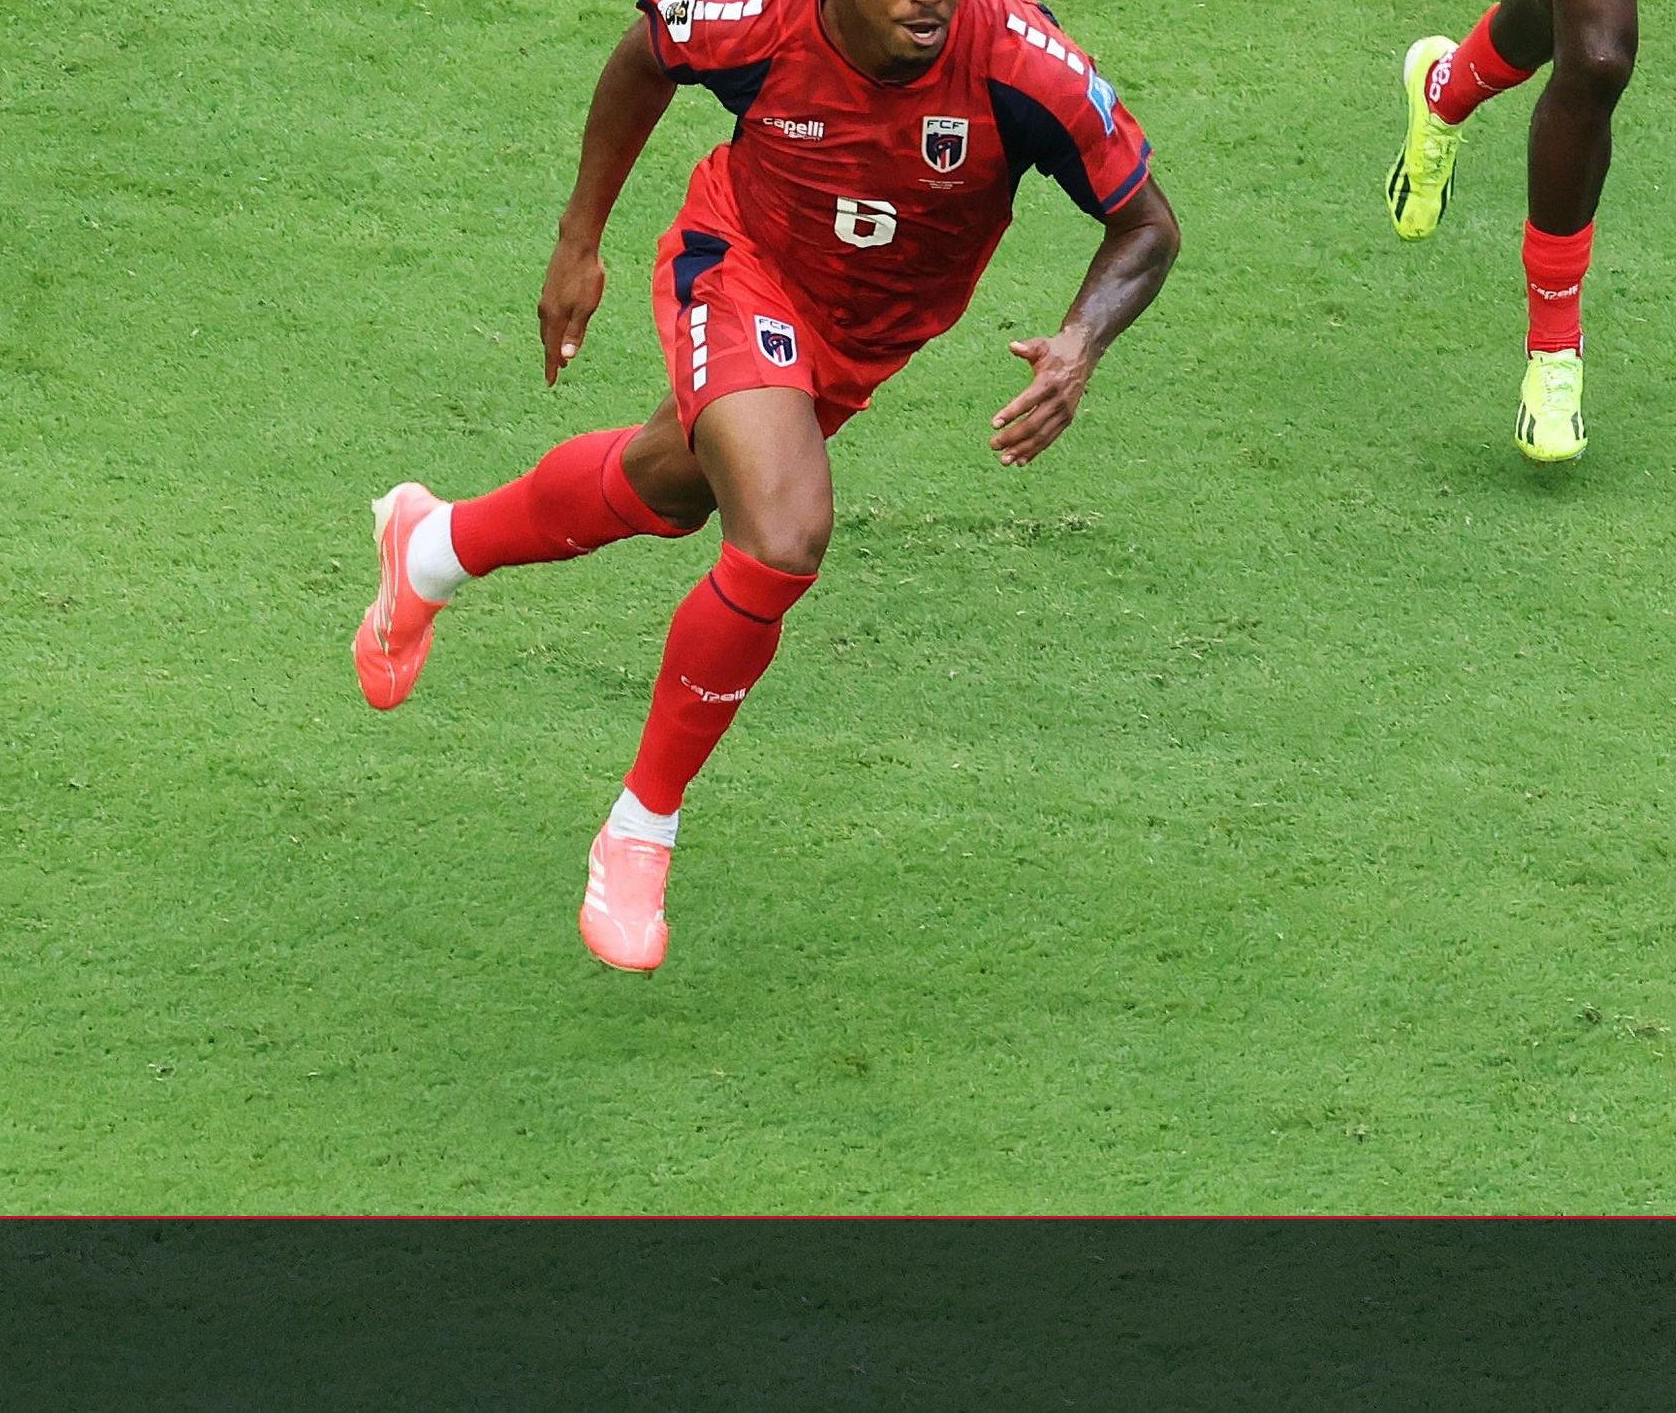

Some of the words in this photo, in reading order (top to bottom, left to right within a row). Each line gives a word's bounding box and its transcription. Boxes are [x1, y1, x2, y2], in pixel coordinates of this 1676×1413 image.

[763, 117, 825, 137] capelli
[926, 119, 965, 130] FCF
[834, 195, 897, 248] 6
